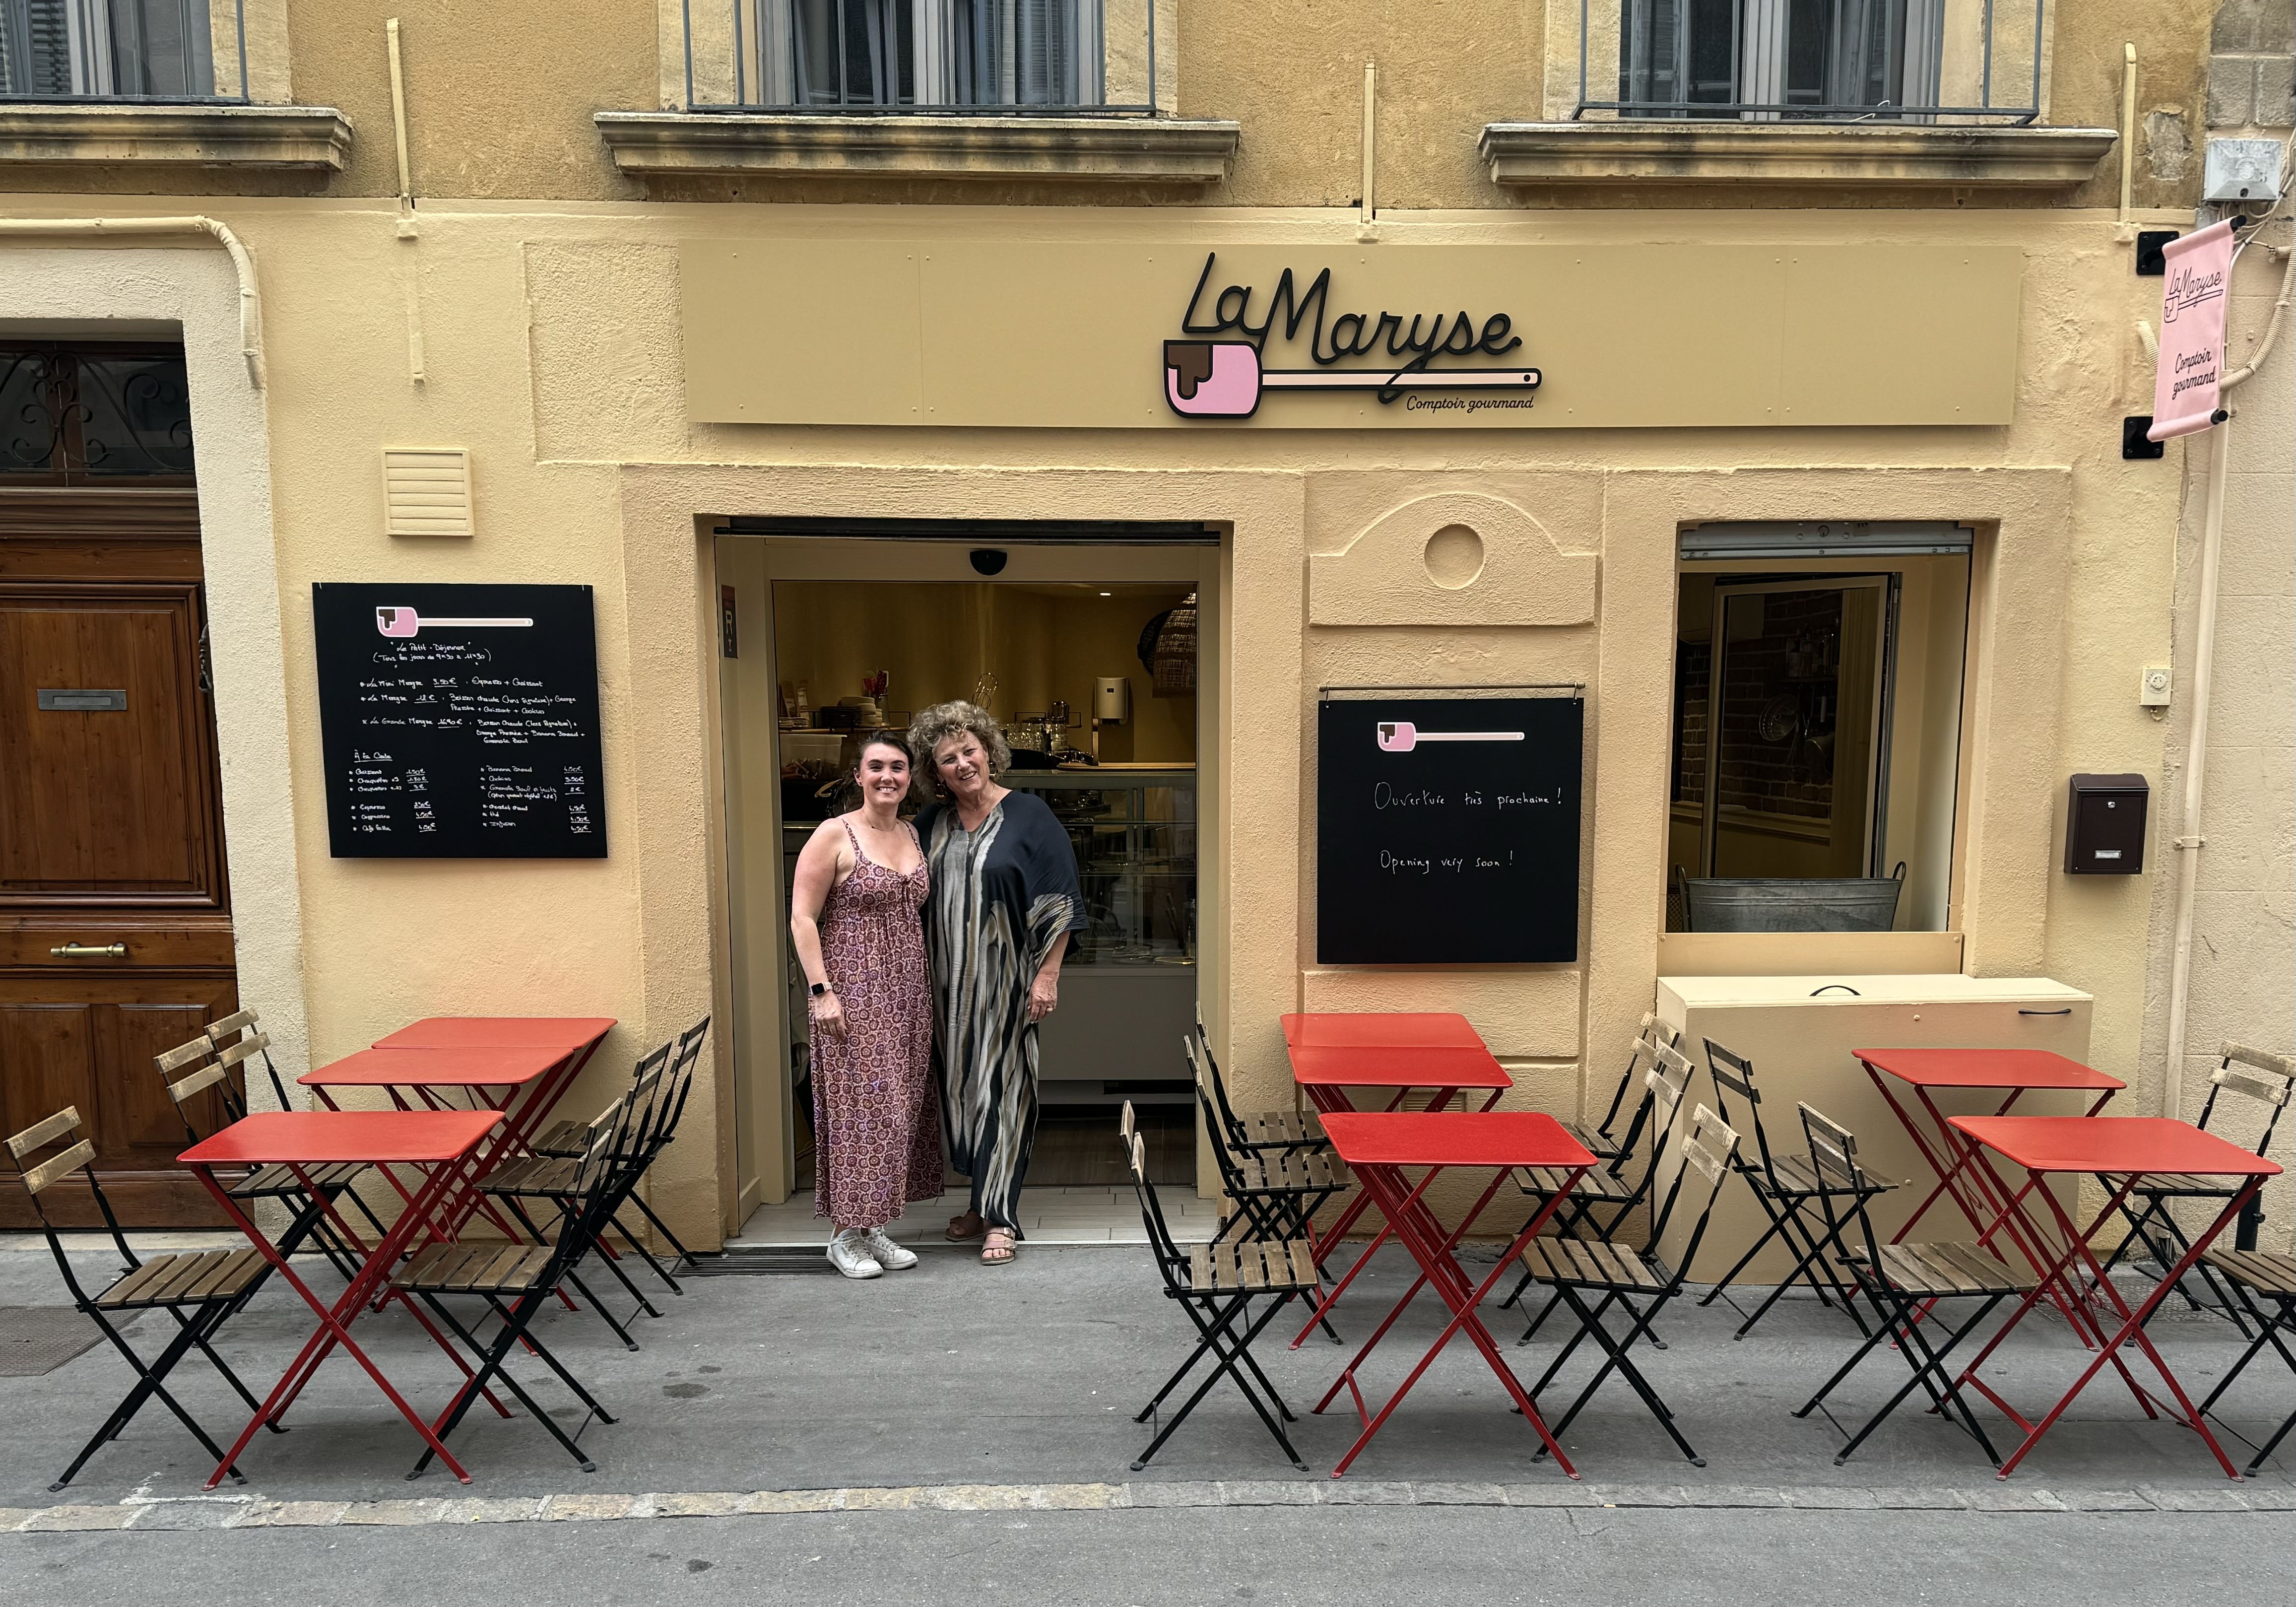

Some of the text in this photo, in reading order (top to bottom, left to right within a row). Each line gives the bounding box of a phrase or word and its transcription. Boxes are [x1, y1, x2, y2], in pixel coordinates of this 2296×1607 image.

[2175, 347, 2212, 374] Comptoir
[2172, 366, 2216, 400] gourmand
[1407, 396, 1534, 413] Comptoir gourmand
[1374, 781, 1445, 809] Ouverture
[1497, 789, 1549, 810] prochaine
[1380, 850, 1430, 874] Opening
[1441, 857, 1463, 872] very
[1475, 858, 1500, 867] soon
